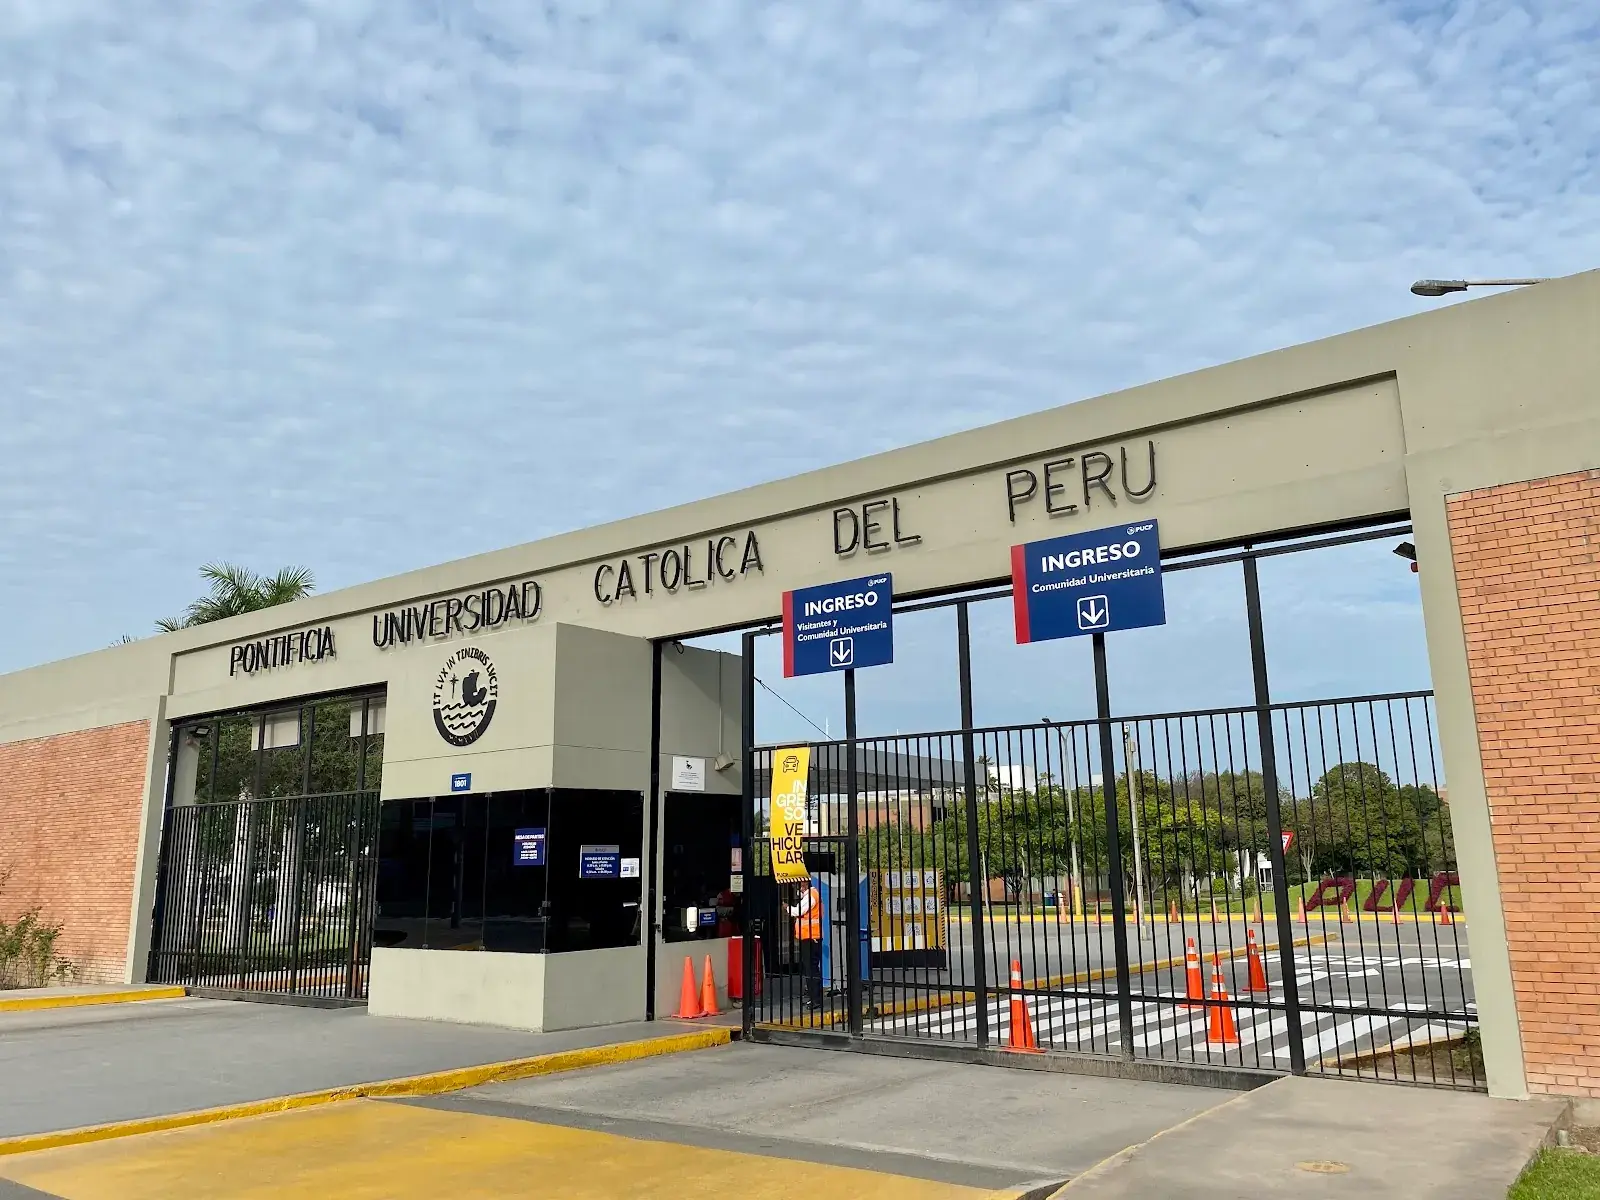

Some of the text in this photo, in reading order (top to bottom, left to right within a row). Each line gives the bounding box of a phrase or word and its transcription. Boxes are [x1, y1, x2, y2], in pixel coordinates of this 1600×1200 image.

[1135, 524, 1153, 533] PUCP
[229, 440, 1157, 676] PONTIFICIA UNIVERSIDAD CATOLICA DEL PERU
[1041, 540, 1141, 573] INGRESO
[873, 577, 887, 585] PUCP
[1032, 566, 1155, 593] Comunidad Universitaria
[804, 591, 878, 617] INGRESO
[797, 620, 831, 631] Visitantes
[797, 621, 887, 641] Comunidad Universitaria
[792, 779, 807, 793] IN
[776, 793, 806, 808] GRE
[783, 806, 806, 821] SO
[784, 823, 804, 836] VE
[772, 837, 802, 851] HICU
[777, 851, 804, 864] LAR
